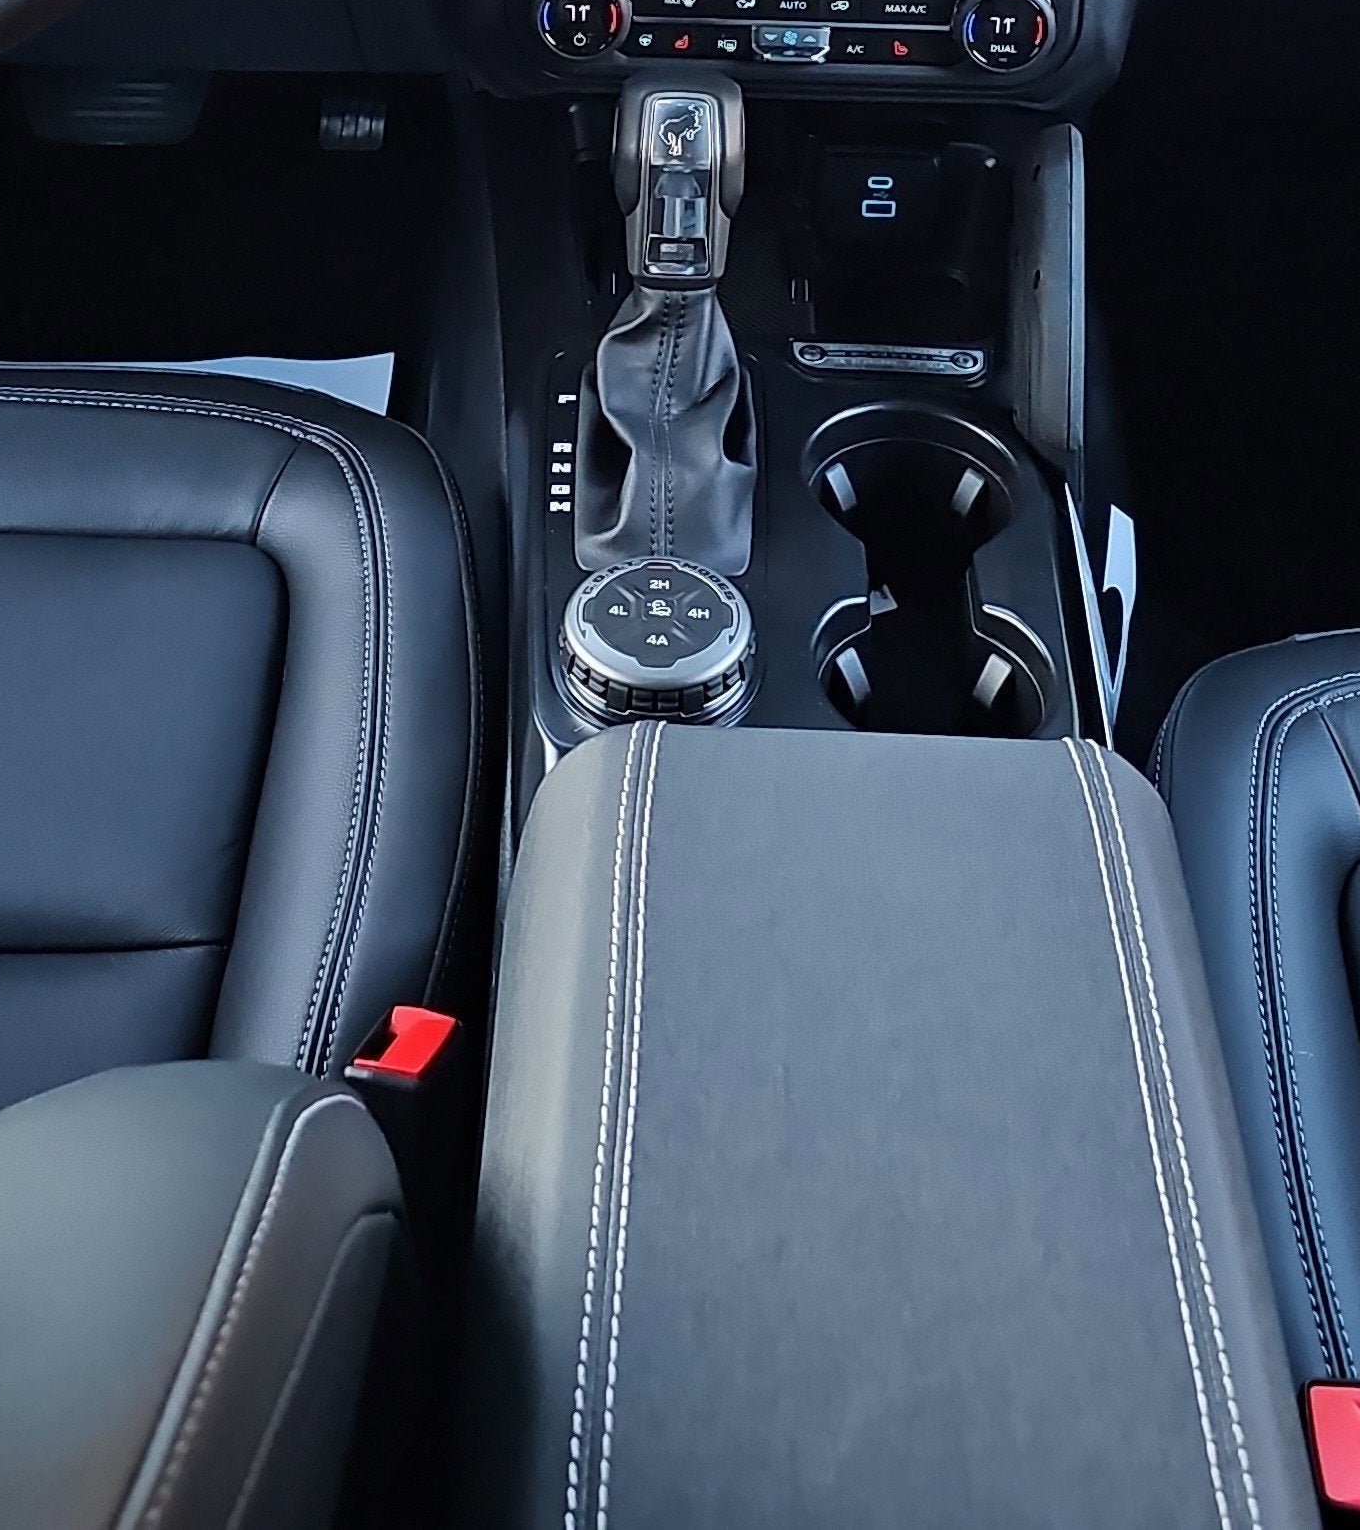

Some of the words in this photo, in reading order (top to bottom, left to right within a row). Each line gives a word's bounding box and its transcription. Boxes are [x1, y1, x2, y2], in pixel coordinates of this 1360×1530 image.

[779, 0, 807, 10] AUTO
[884, 4, 908, 14] MAX
[908, 5, 927, 15] A/C
[846, 45, 865, 55] A/C
[990, 44, 1017, 54] DUAL
[551, 462, 572, 473] N
[549, 501, 572, 512] M
[649, 579, 670, 590] 2H
[608, 605, 629, 616] 4L
[687, 608, 710, 619] 4H
[645, 634, 669, 646] 4A
